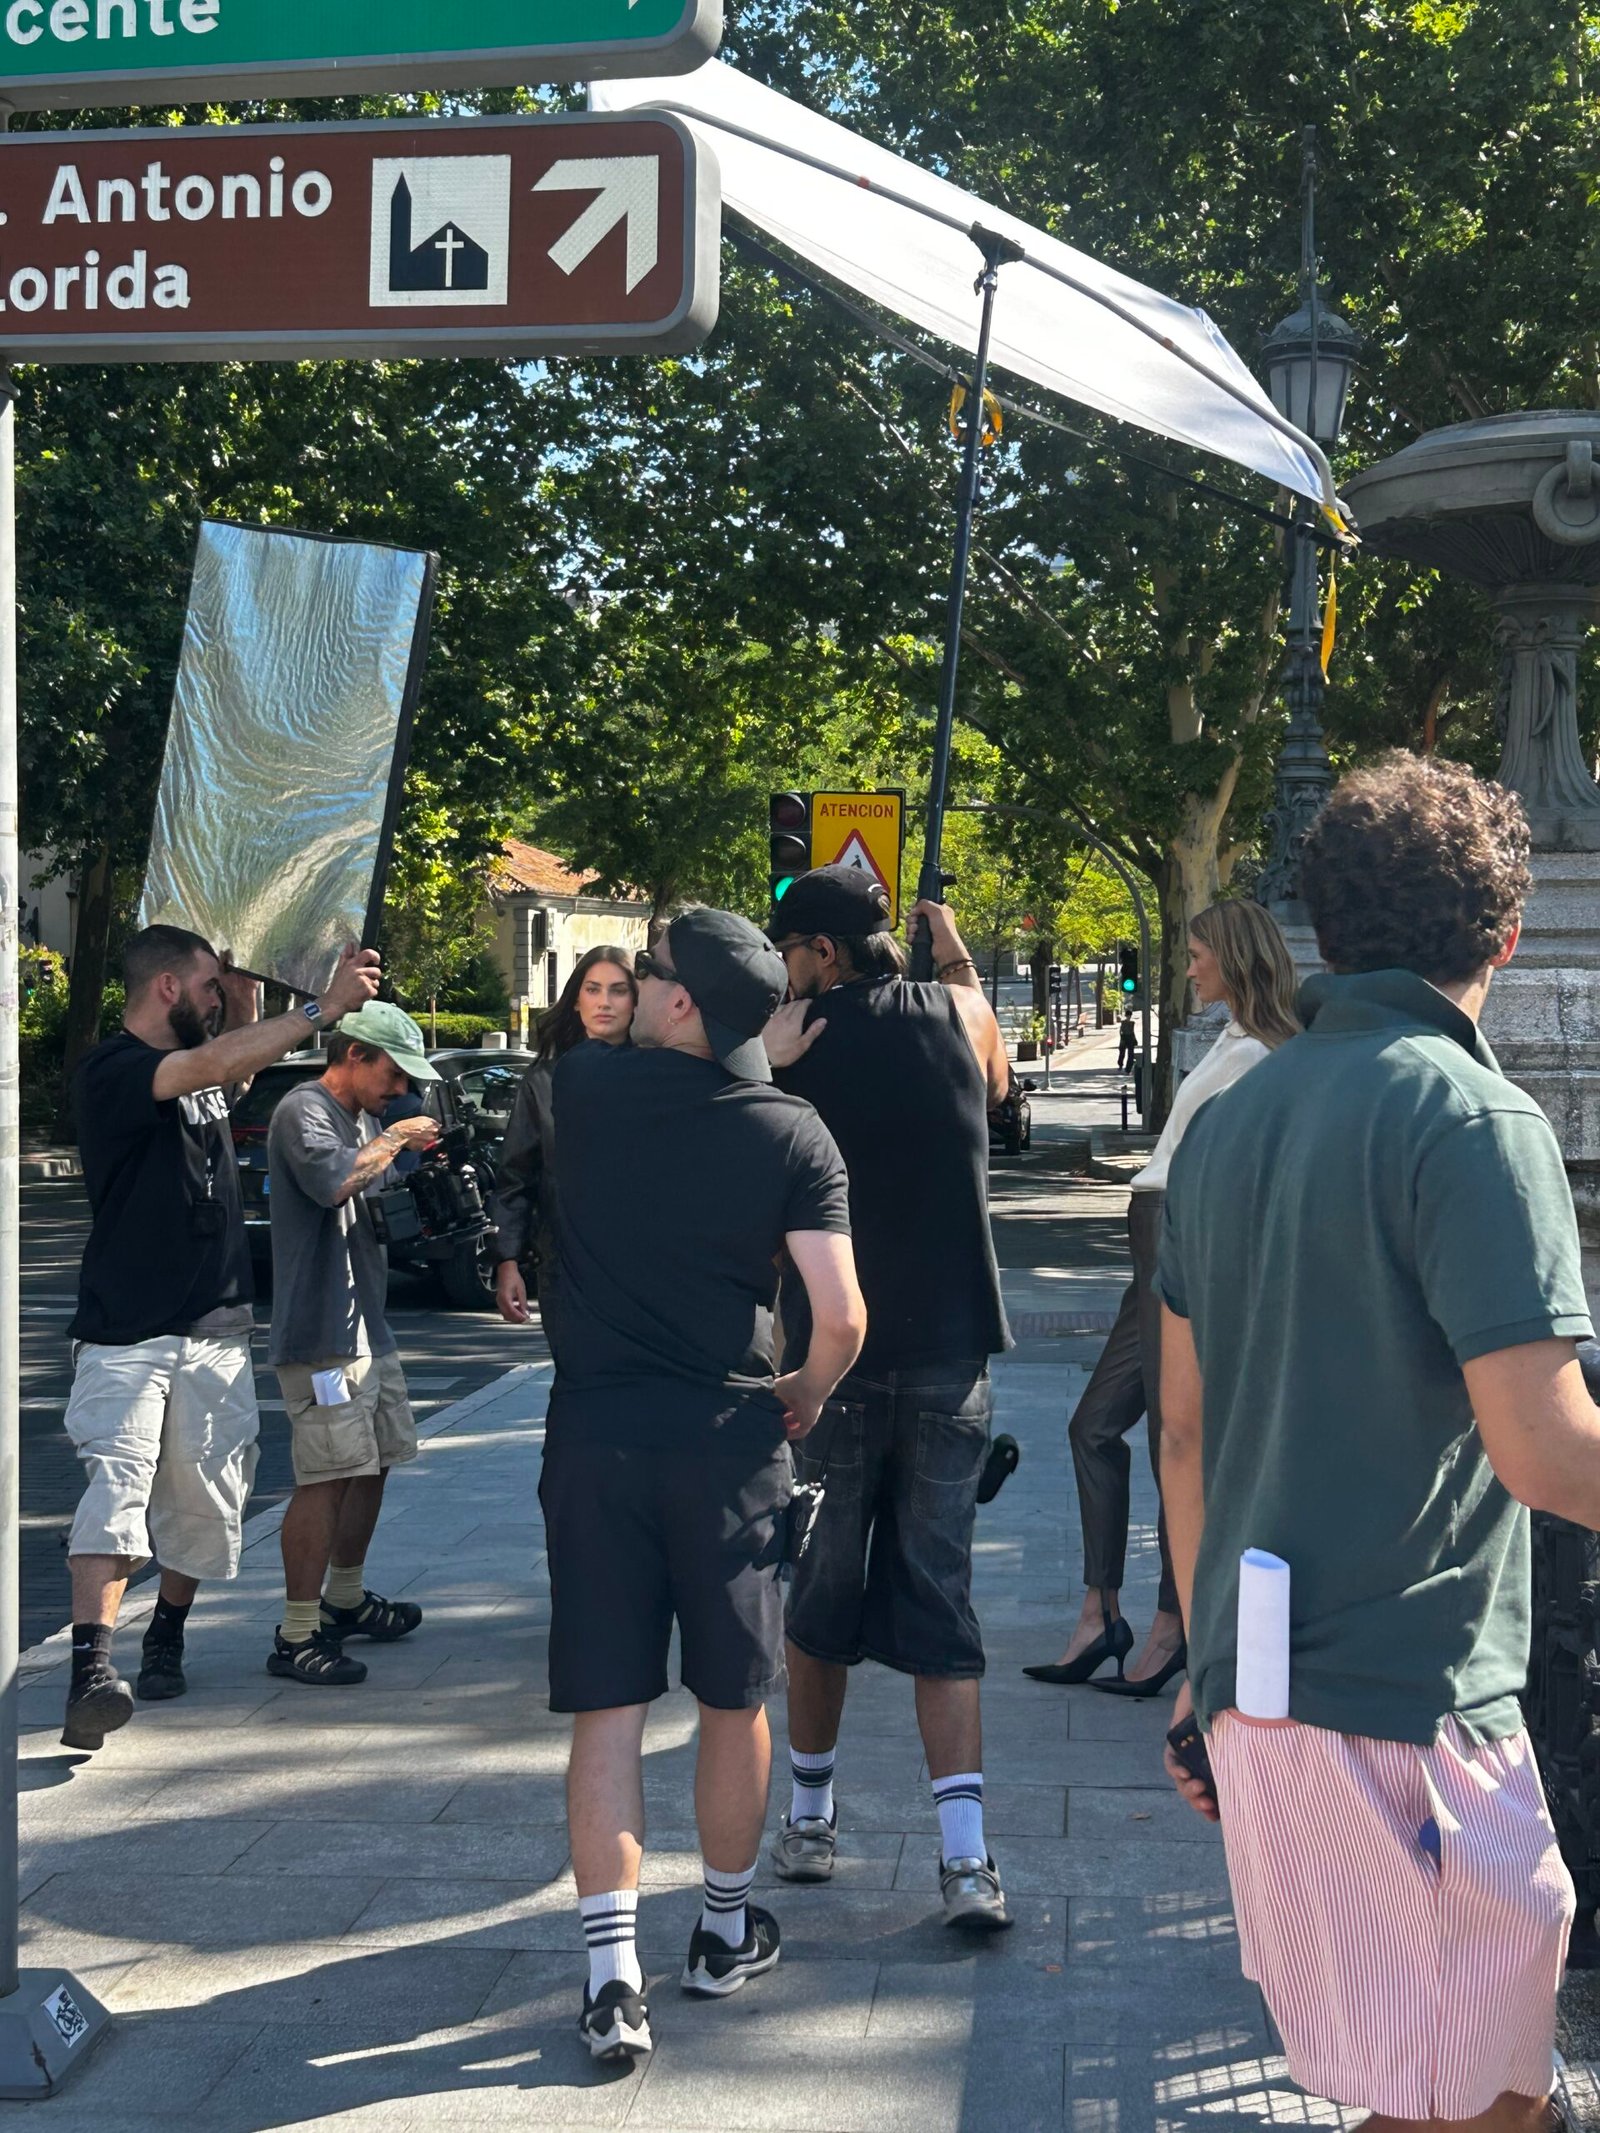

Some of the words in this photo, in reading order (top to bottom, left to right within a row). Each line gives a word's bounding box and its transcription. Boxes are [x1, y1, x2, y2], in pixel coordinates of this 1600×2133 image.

[6, 0, 220, 45] cente
[42, 156, 332, 224] Antonio
[0, 250, 191, 312] orida
[820, 803, 894, 818] ATENCION
